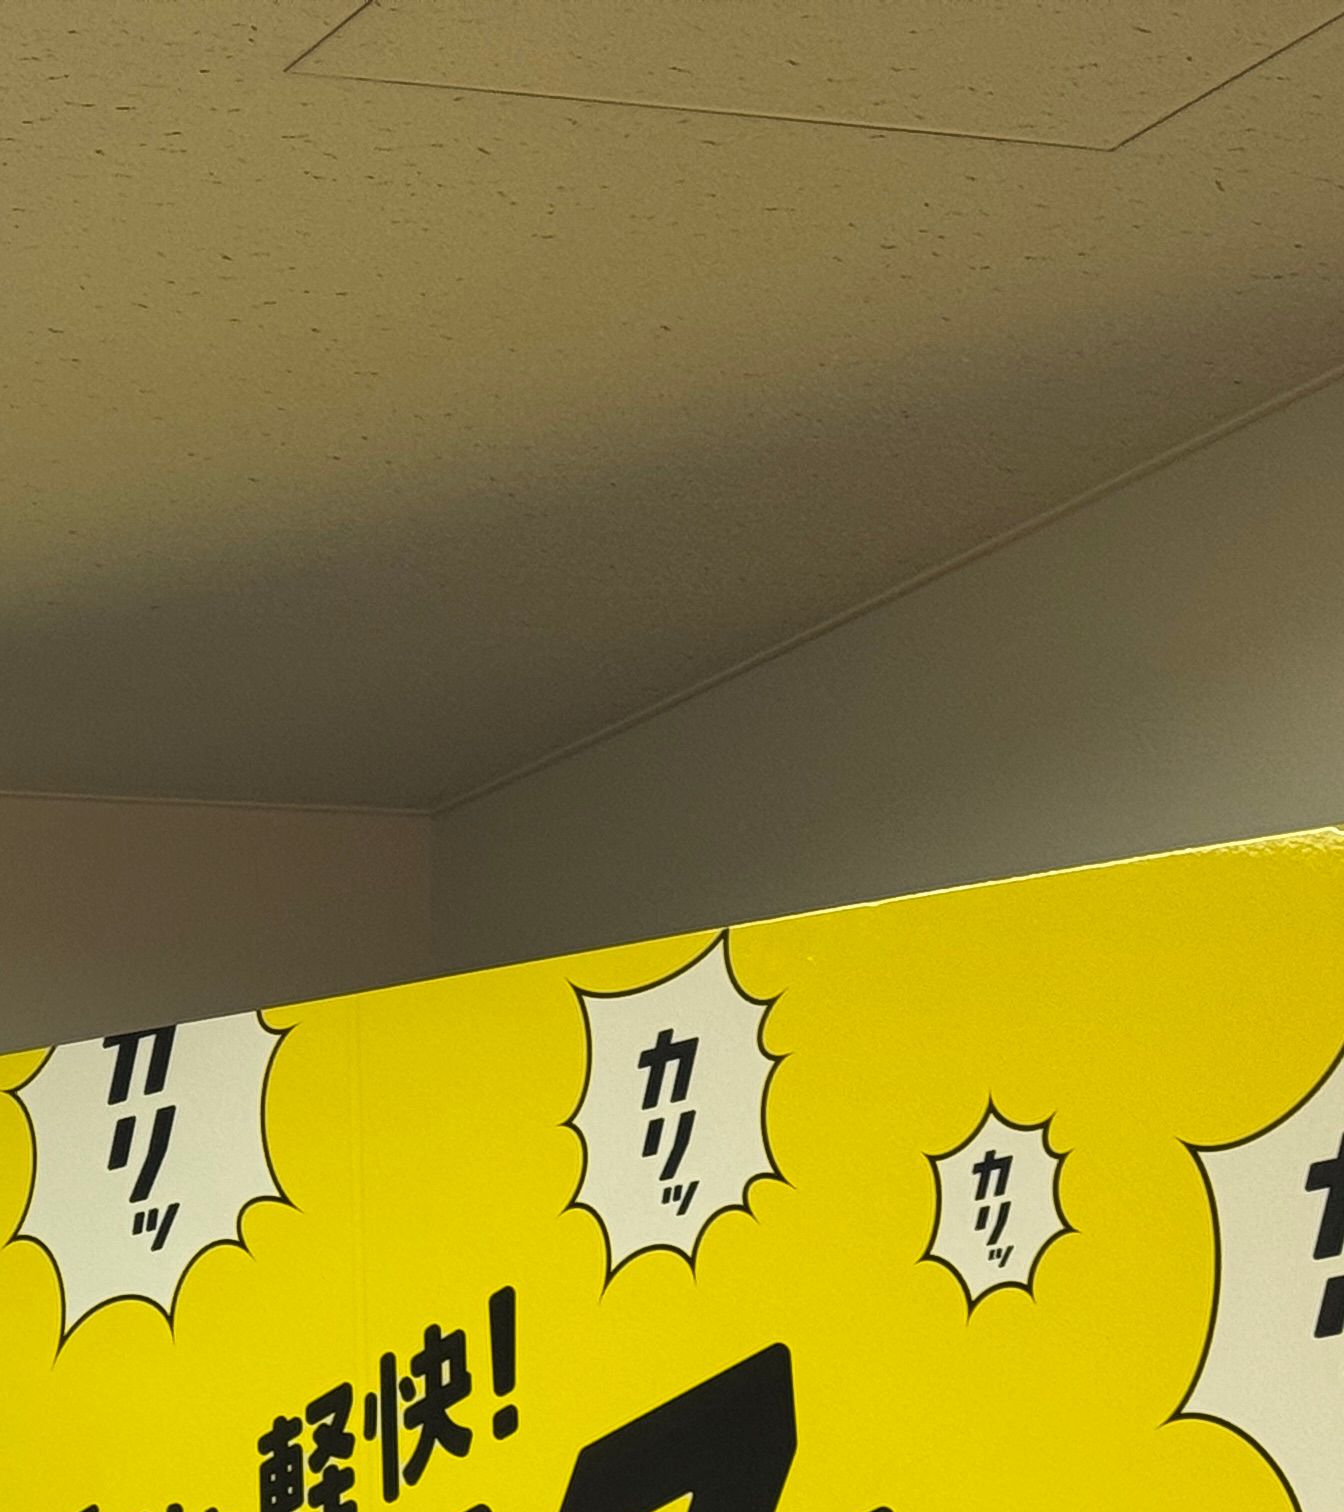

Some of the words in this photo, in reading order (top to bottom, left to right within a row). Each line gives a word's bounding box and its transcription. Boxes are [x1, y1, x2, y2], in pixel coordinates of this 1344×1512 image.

[638, 1028, 699, 1216] カリッ
[972, 1149, 1013, 1268] カリッ
